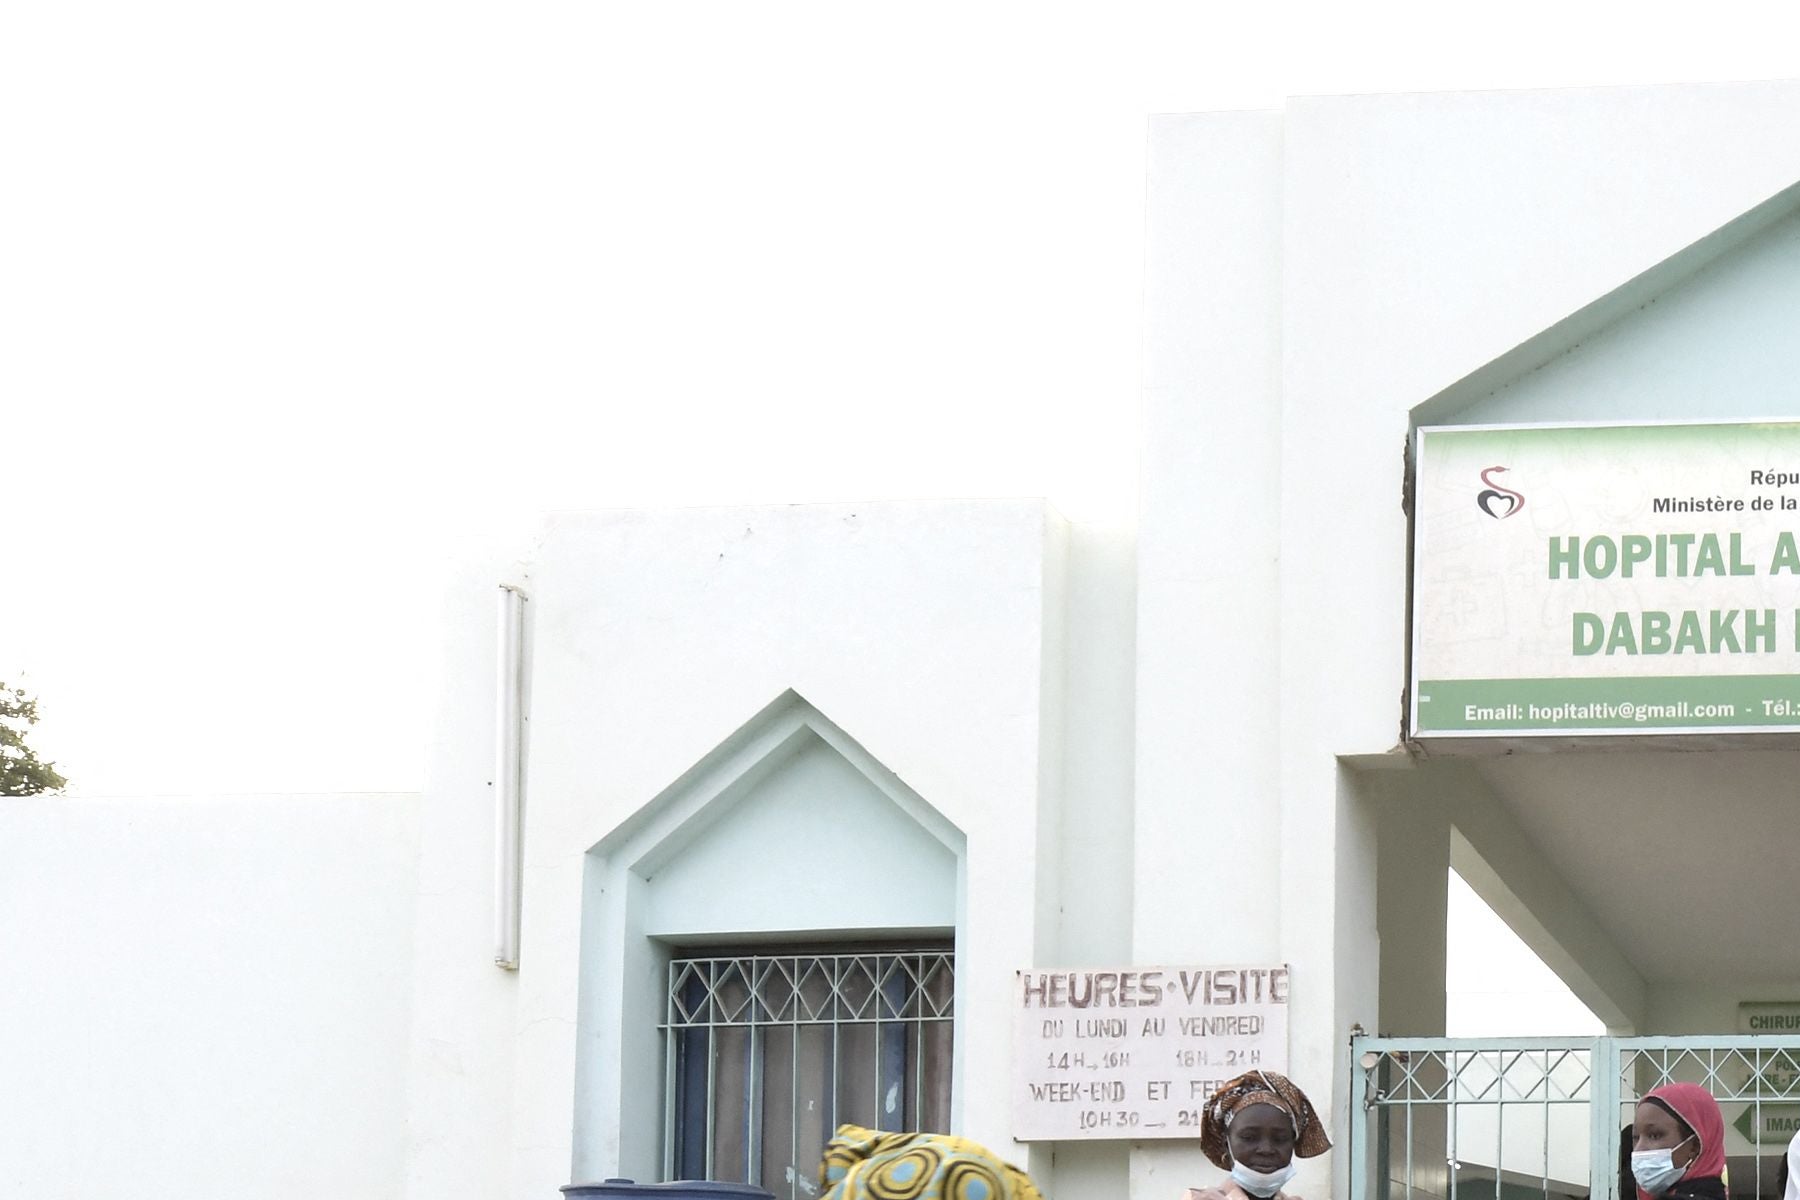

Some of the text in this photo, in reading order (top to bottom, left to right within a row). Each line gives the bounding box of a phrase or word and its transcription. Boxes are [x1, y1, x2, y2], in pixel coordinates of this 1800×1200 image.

[1653, 497, 1745, 513] Ministère
[1751, 495, 1774, 511] de
[1781, 495, 1797, 510] la
[1549, 533, 1755, 580] HOPITAL
[1573, 609, 1776, 656] DABAKH
[1465, 703, 1523, 721] Email:
[1529, 701, 1735, 723] hopitaltiv@gmail.com
[1023, 968, 1288, 1008] HEURES VISITE
[1042, 1015, 1265, 1039] DU LUNDI AU VENDREDI
[1029, 1080, 1126, 1102] WEEK-END
[1147, 1080, 1172, 1101] ET
